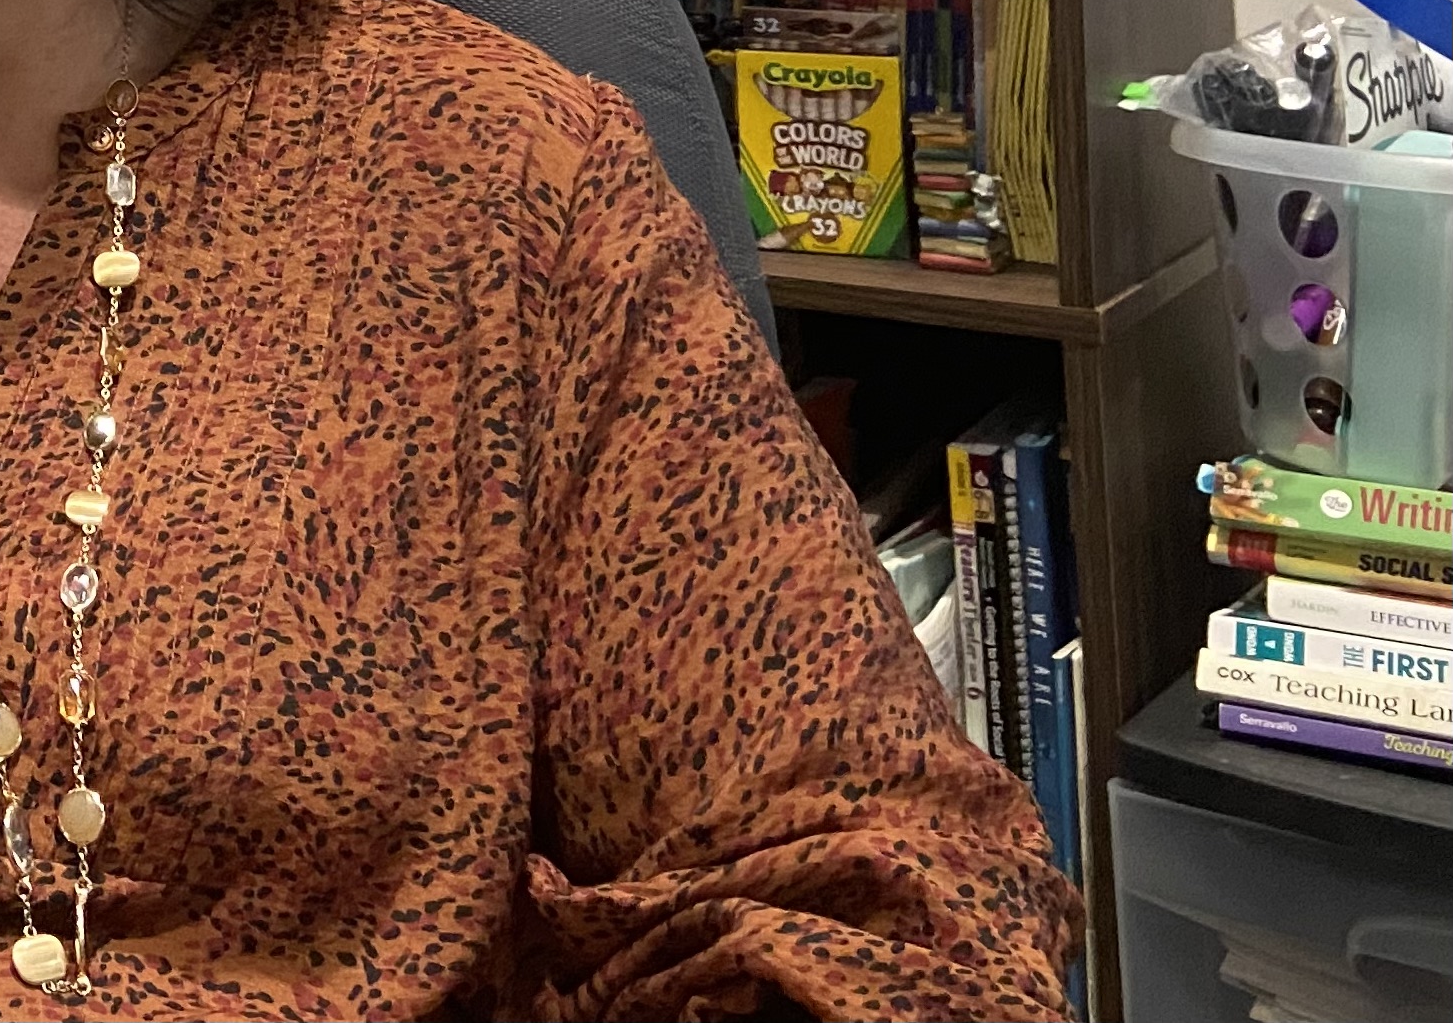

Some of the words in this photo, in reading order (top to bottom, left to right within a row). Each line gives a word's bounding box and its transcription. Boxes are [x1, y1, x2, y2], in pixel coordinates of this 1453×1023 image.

[753, 17, 781, 33] 32
[763, 62, 872, 88] Crayola
[1347, 50, 1444, 143] Sharpie
[774, 123, 867, 149] COLORS
[791, 145, 864, 170] WORLD
[782, 195, 866, 219] CRAYONS
[811, 218, 838, 236] 32
[1359, 553, 1434, 582] SOCIAL
[984, 605, 996, 646] Getting
[1290, 599, 1338, 614] HARDIN
[1371, 610, 1452, 634] EFFECTIVE
[987, 648, 999, 660] to
[1342, 644, 1365, 669] THE
[1372, 649, 1449, 683] FIRST
[988, 662, 1000, 679] the
[990, 681, 1002, 710] Roots
[1270, 673, 1400, 717] Teaching
[991, 711, 1003, 724] of
[992, 726, 1006, 757] Social
[1239, 713, 1298, 733] Serravallo
[1383, 733, 1453, 765] Teaching
